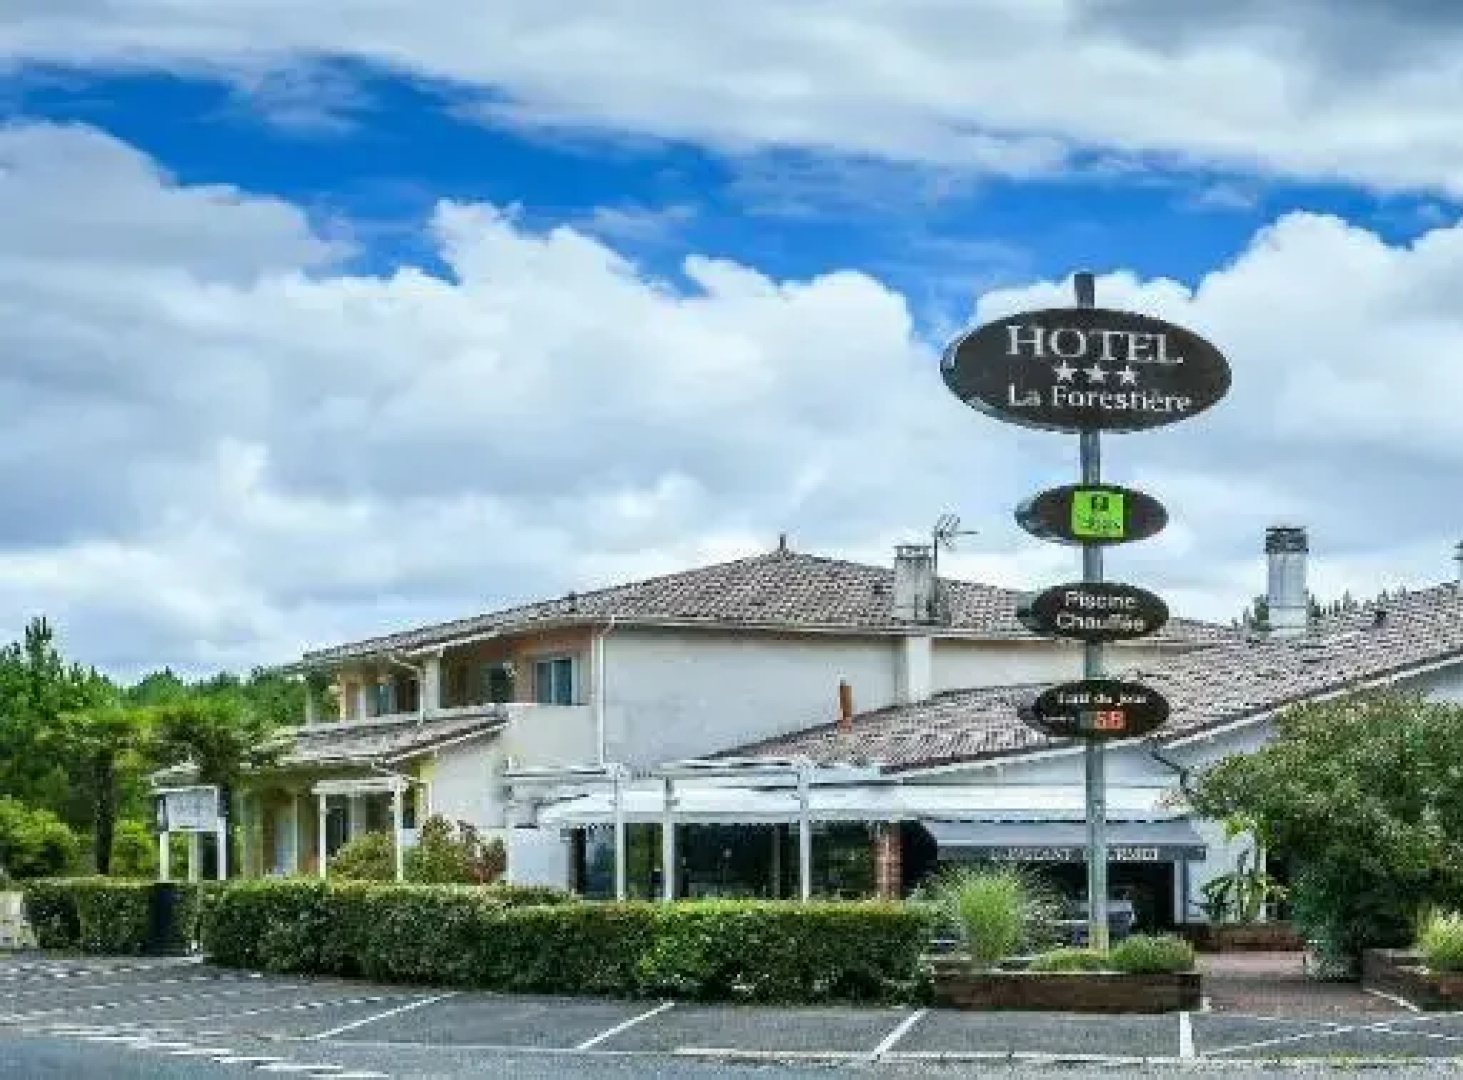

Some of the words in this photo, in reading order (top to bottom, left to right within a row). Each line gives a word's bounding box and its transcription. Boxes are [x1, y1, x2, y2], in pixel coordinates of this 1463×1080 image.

[1004, 324, 1184, 365] HOTEL
[1008, 383, 1042, 408] La
[1052, 385, 1193, 413] Forestière
